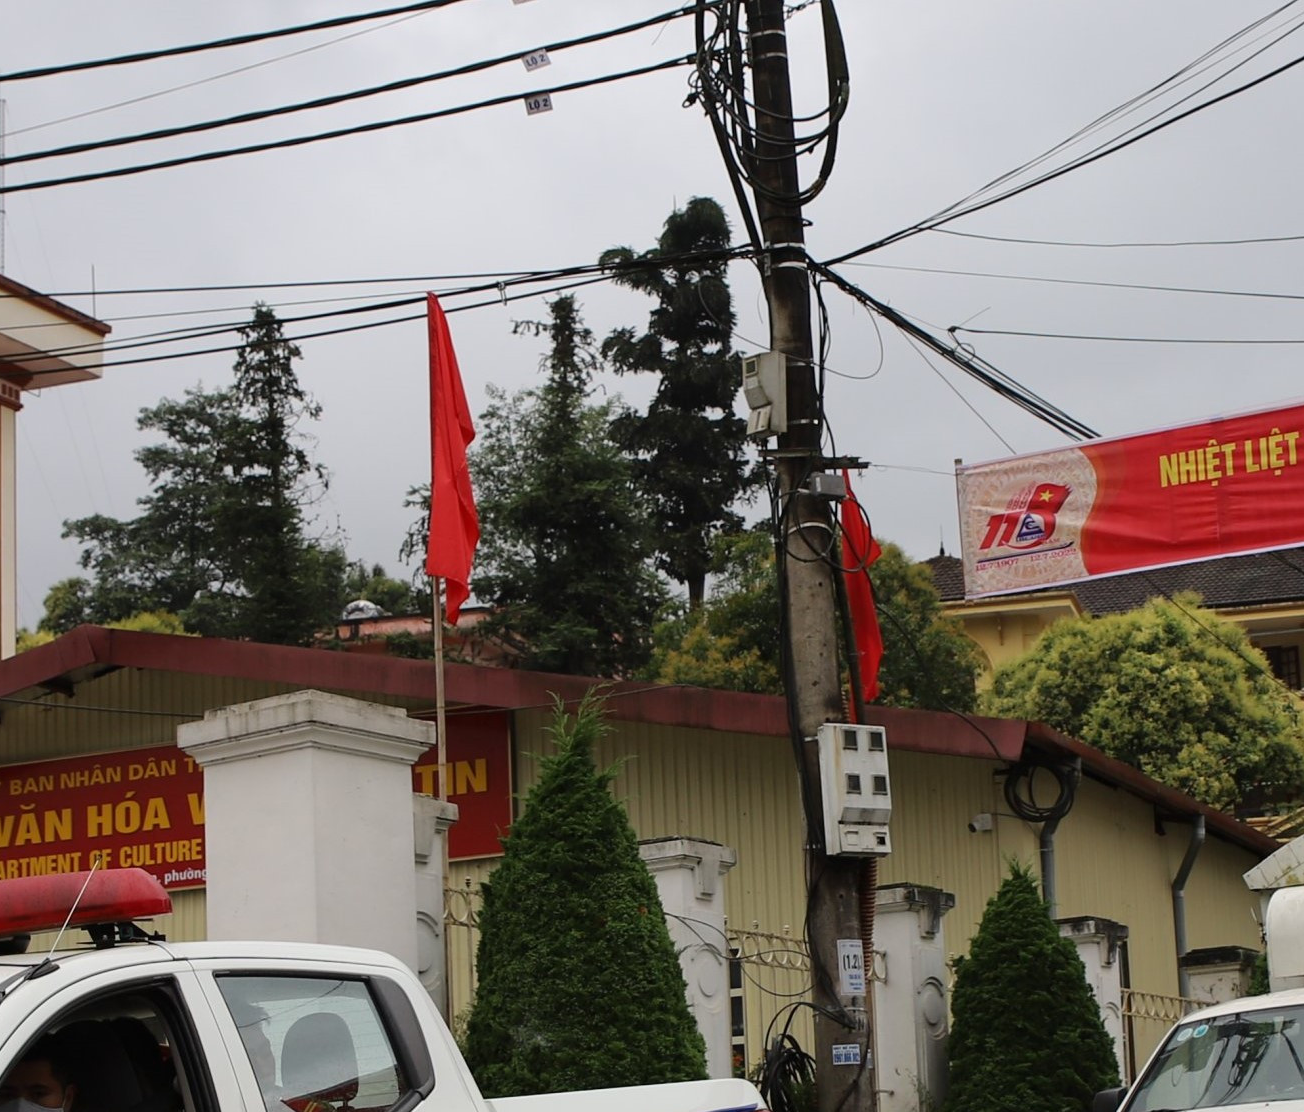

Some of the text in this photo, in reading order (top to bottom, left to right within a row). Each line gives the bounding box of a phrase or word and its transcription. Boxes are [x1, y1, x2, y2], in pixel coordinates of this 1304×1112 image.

[1159, 439, 1238, 488] NHIỆT
[1244, 428, 1301, 476] LIỆT
[9, 776, 55, 796] BAN
[60, 764, 122, 789] NHÂN
[128, 757, 177, 781] DÂN
[86, 791, 171, 836] HÓA
[88, 849, 112, 871] OF
[119, 838, 203, 868] CULTURE
